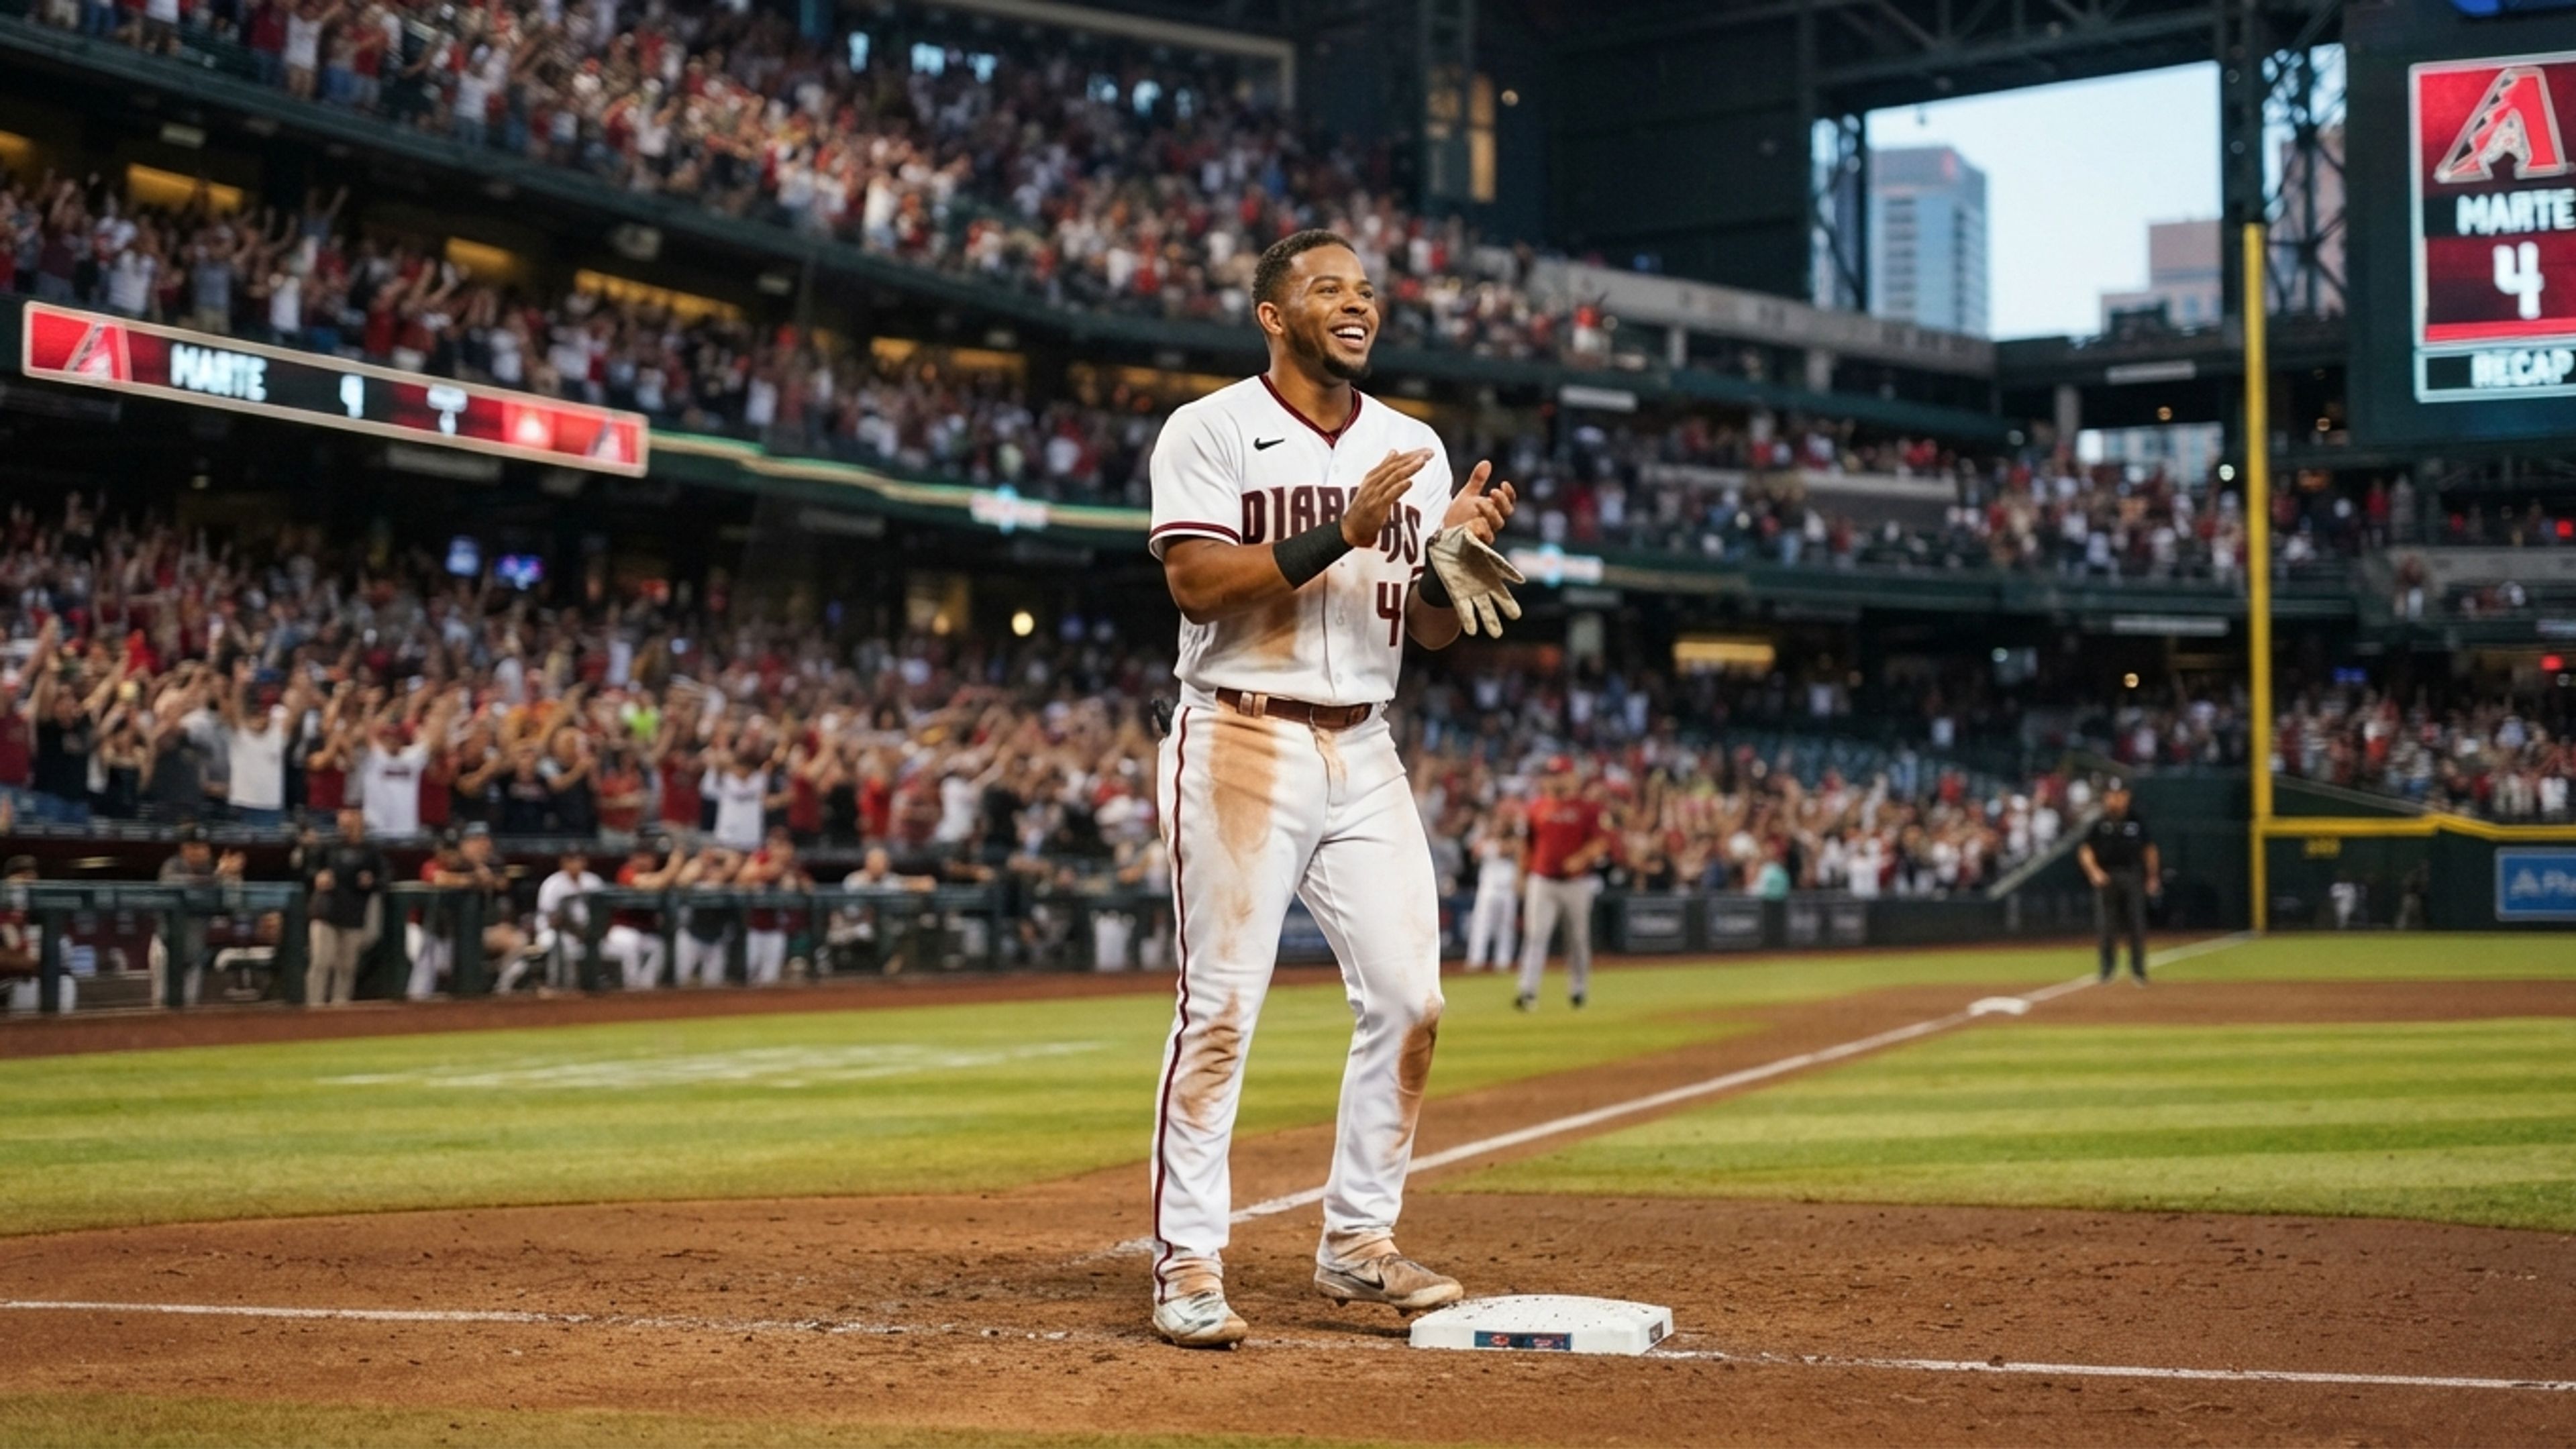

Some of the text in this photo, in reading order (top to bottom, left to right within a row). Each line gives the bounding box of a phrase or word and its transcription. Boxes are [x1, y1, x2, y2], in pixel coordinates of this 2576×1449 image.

[2456, 189, 2575, 235] MARTE
[2493, 241, 2544, 320] 4
[1377, 582, 1401, 647] 4
